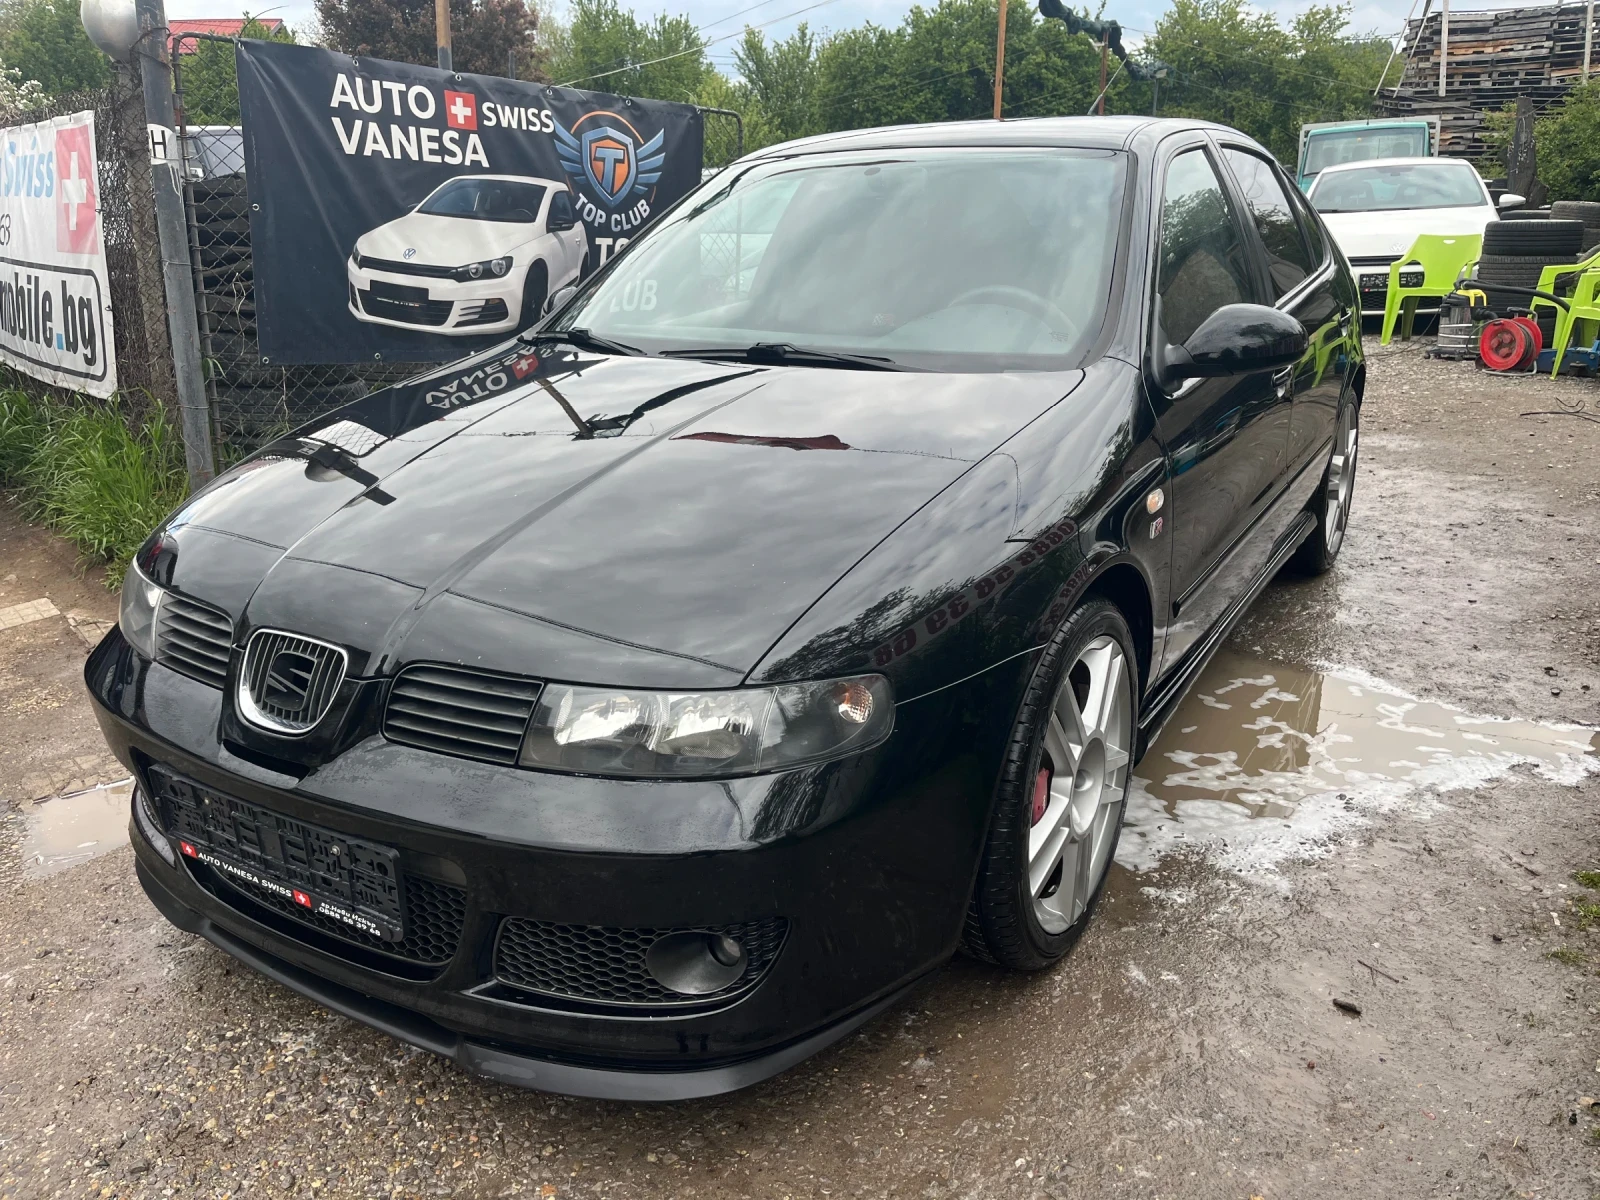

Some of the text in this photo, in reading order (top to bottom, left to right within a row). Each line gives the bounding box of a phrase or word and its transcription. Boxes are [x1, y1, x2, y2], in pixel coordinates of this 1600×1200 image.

[330, 73, 555, 133] AUTO SWISS
[4, 136, 54, 198] Swiss
[331, 117, 491, 169] VANESA
[574, 192, 651, 232] TOP CLUB
[198, 852, 292, 897] AUTO VANESA SWISS
